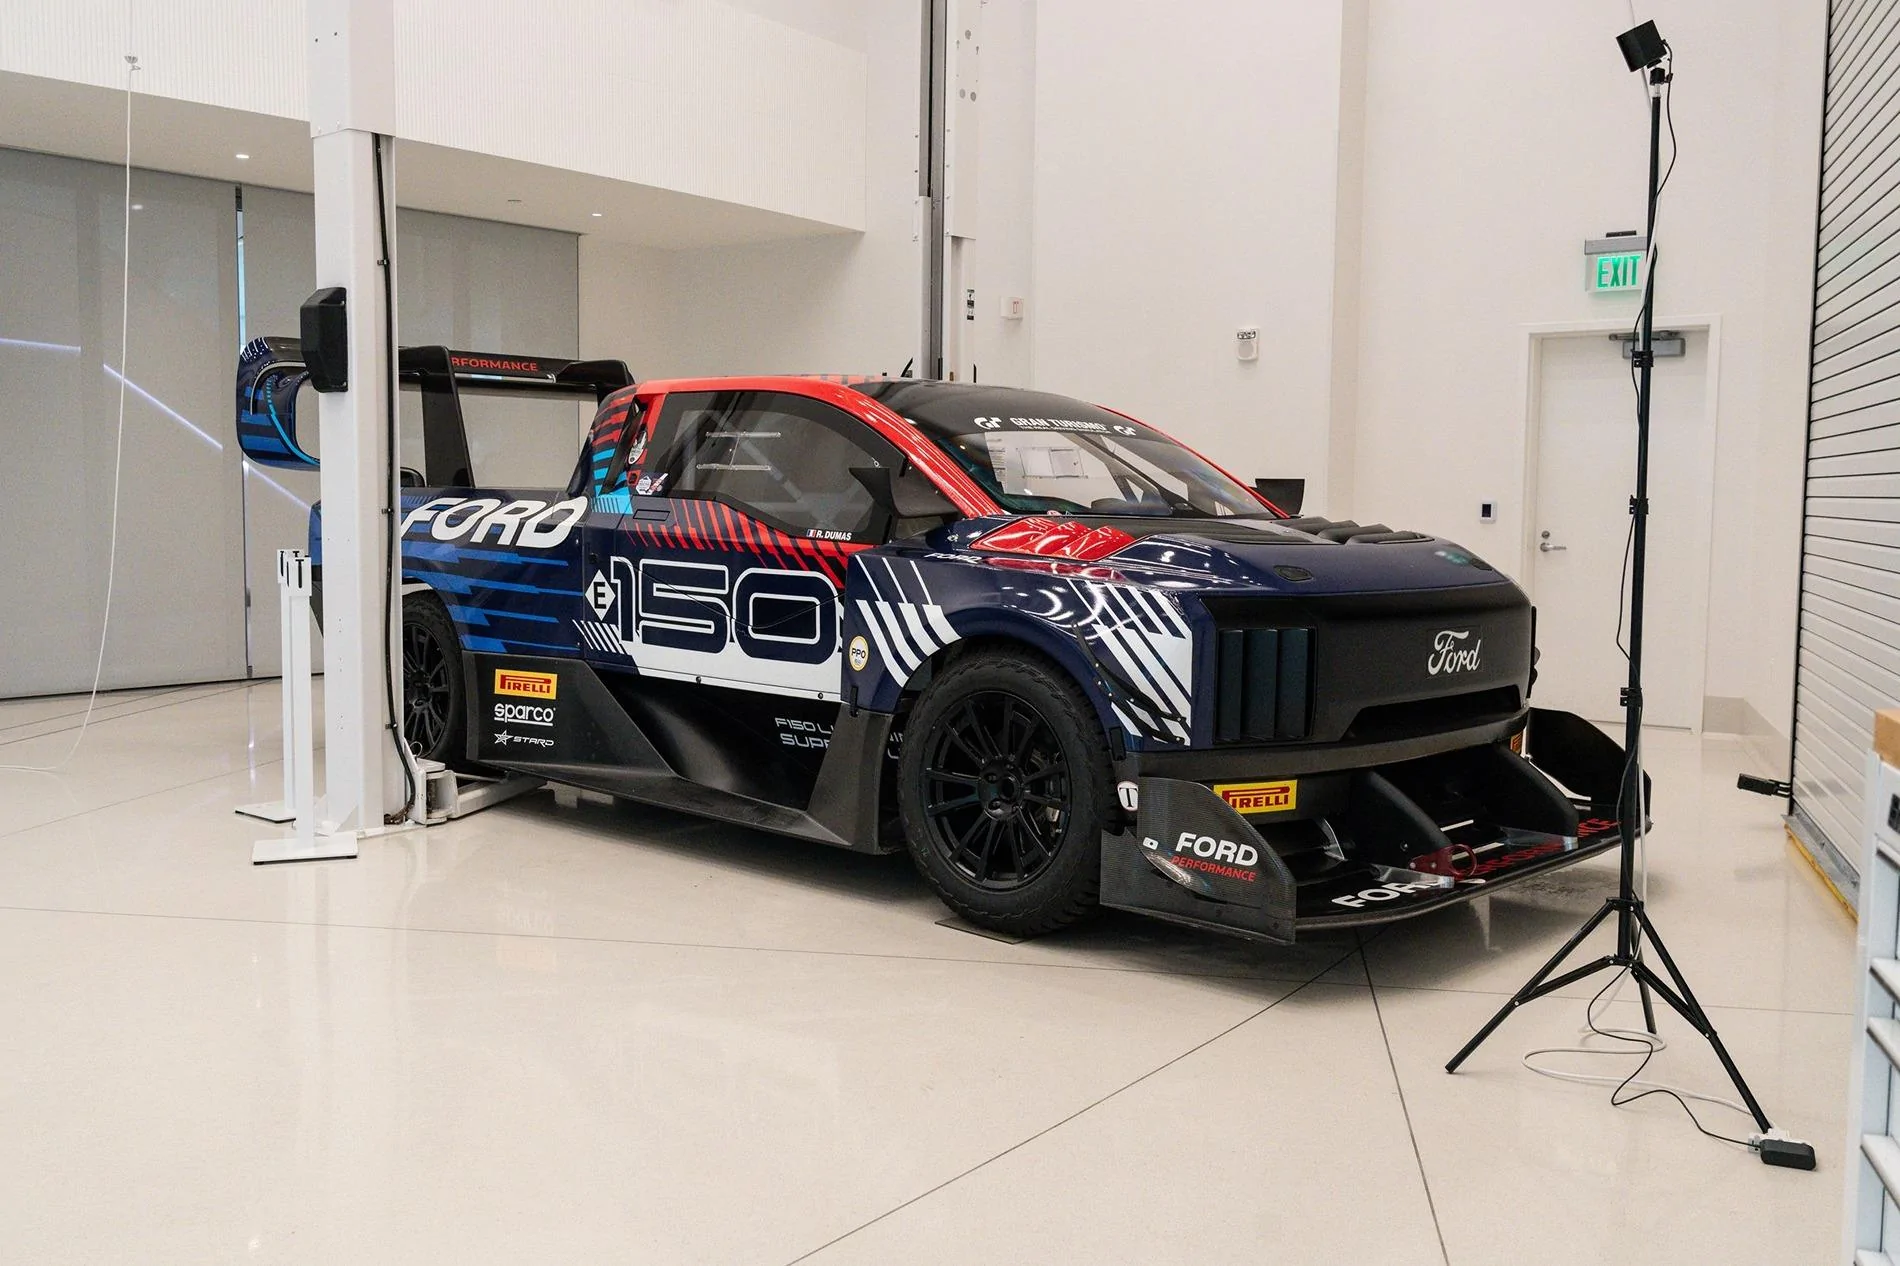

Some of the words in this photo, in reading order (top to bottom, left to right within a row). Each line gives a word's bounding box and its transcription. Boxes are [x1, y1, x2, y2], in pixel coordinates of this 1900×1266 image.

[1596, 254, 1642, 288] EXIT
[450, 356, 538, 371] RFORMANCE
[1009, 417, 1050, 428] GRAN
[1048, 418, 1107, 431] TURISMO
[401, 496, 588, 548] FORD
[816, 529, 824, 539] R.
[824, 531, 852, 541] DUMAS
[593, 582, 607, 609] E
[610, 555, 839, 666] 150
[851, 647, 866, 659] PPO
[1428, 630, 1481, 675] Ford
[500, 674, 552, 693] PIRELLI
[494, 703, 554, 723] sparco
[774, 717, 816, 732] F150
[818, 722, 834, 735] L
[513, 735, 555, 747] STARD
[1222, 786, 1290, 809] PIRELLI
[1175, 832, 1258, 867] FORD
[1171, 855, 1257, 882] PERFORMANCE
